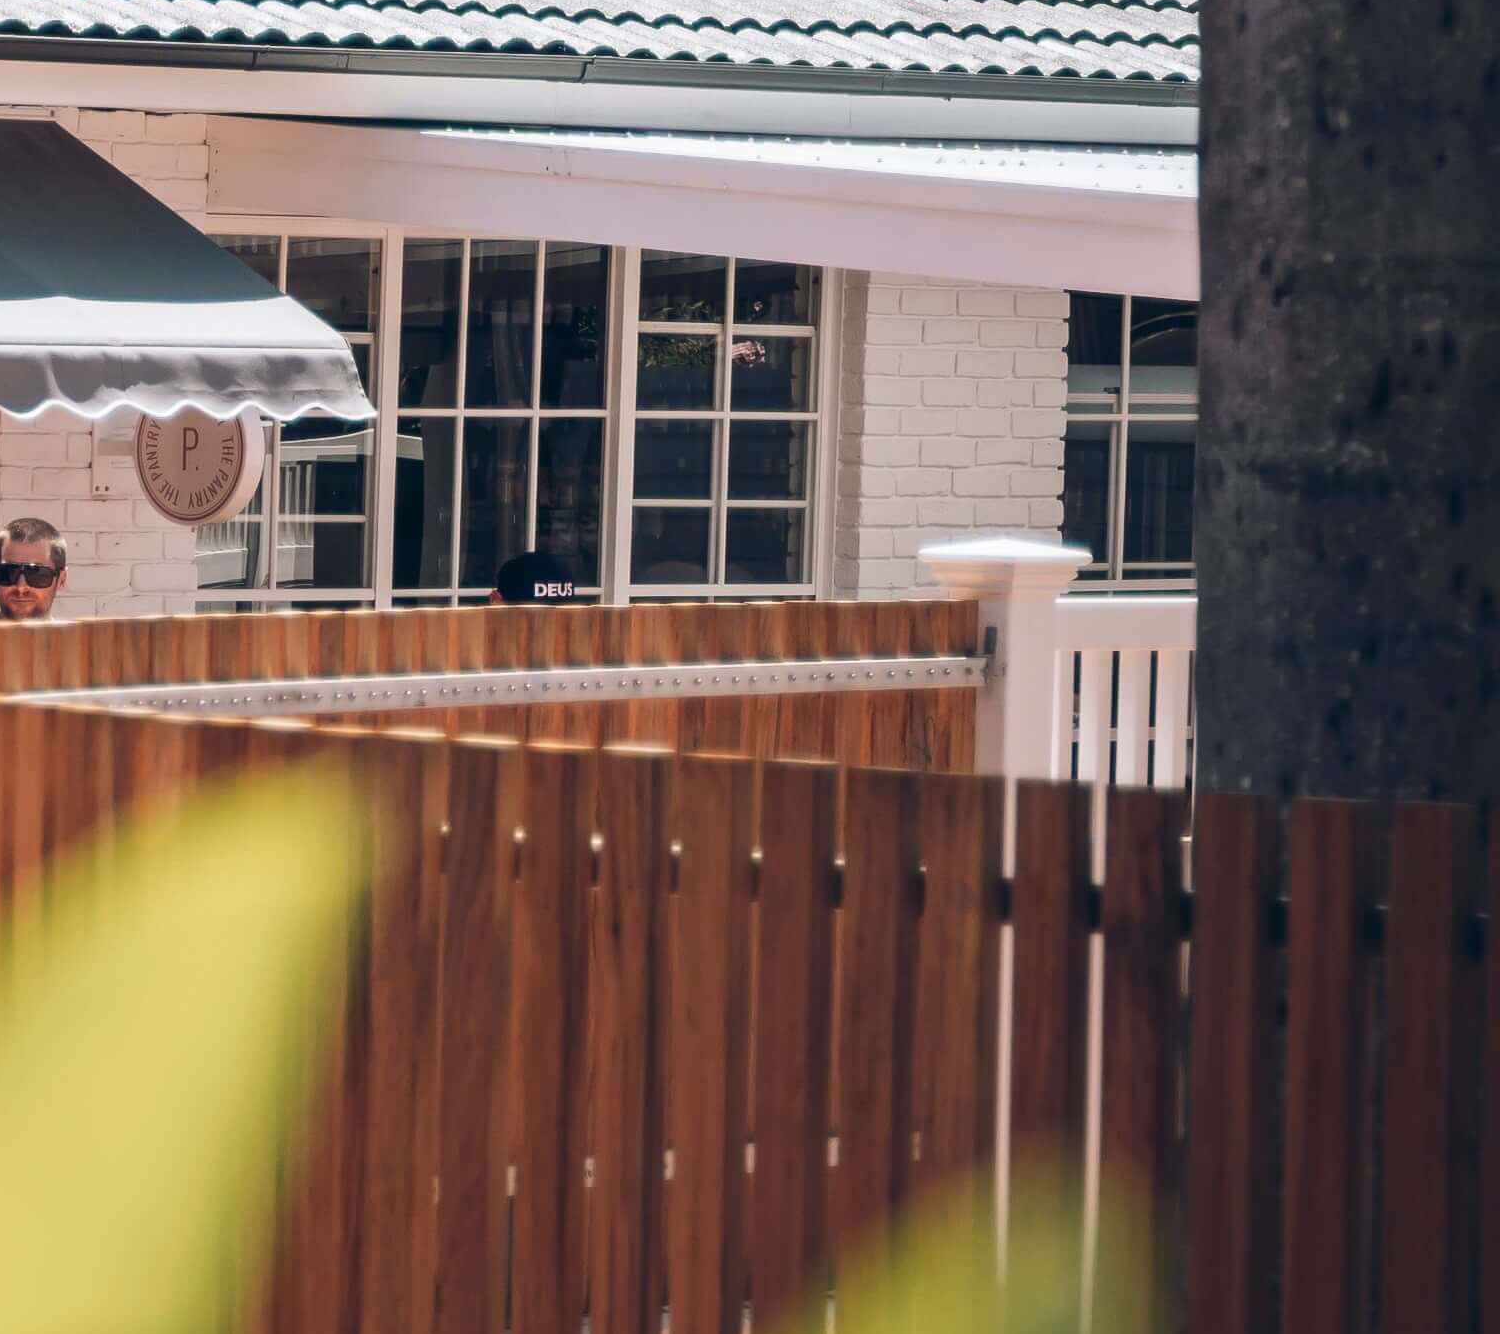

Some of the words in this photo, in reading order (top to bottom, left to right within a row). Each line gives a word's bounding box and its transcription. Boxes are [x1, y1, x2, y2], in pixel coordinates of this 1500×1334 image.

[145, 418, 164, 483] PANTRY
[220, 434, 236, 467] THE
[157, 478, 181, 507] THE
[187, 467, 229, 510] PANTRY
[534, 582, 573, 596] DEUS
